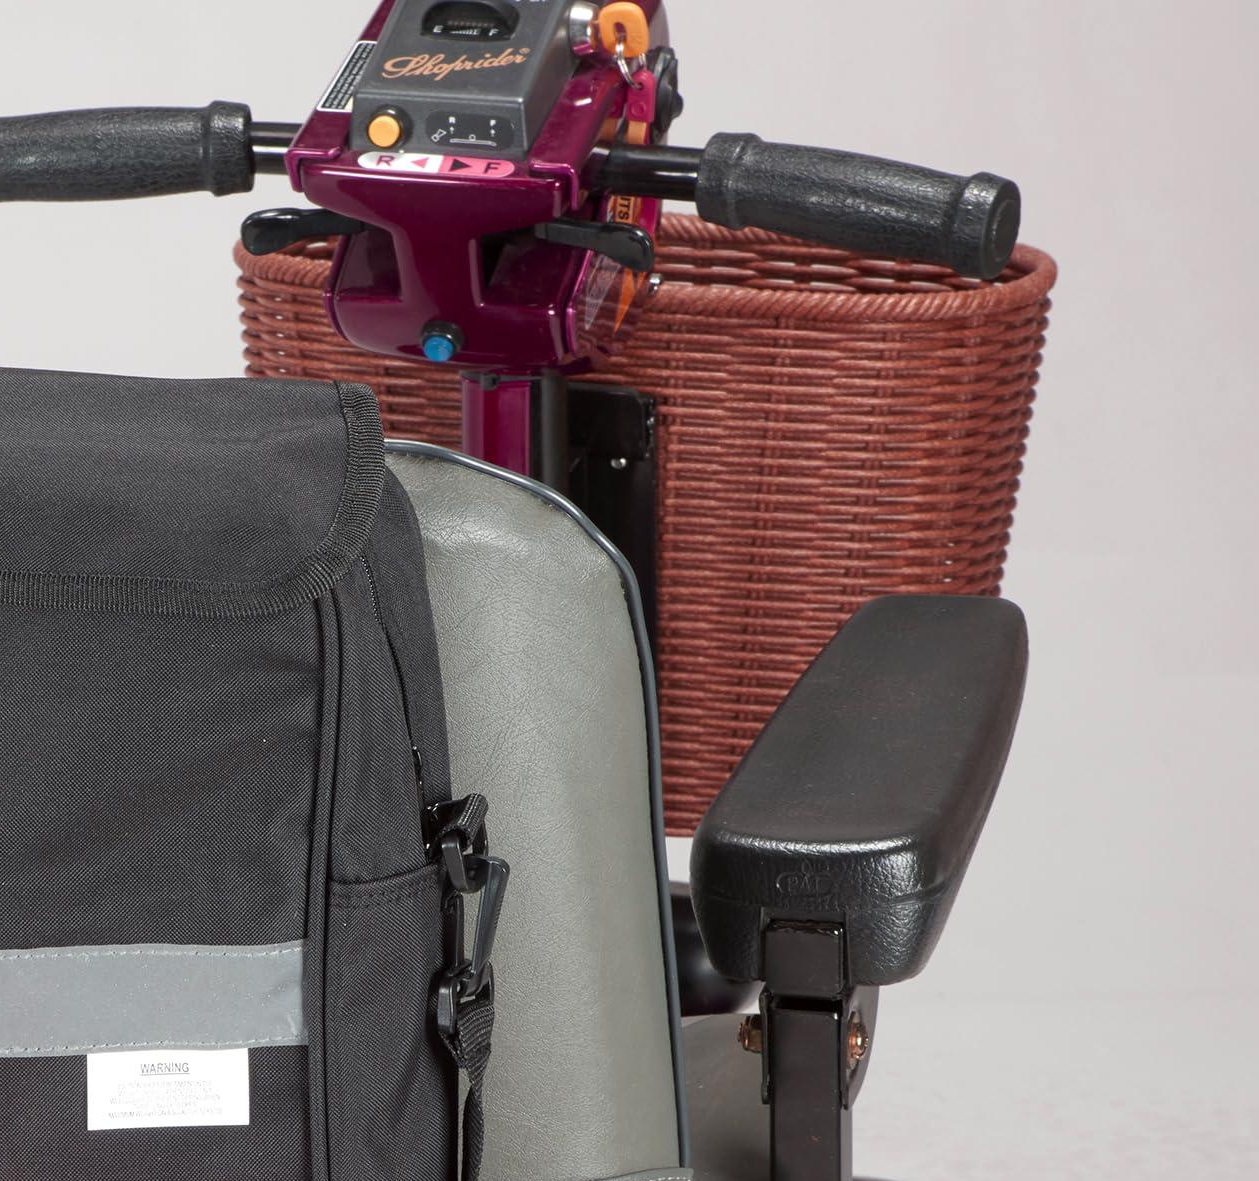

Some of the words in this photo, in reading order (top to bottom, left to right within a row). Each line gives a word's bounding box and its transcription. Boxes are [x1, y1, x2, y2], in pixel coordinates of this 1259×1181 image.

[432, 25, 442, 34] E
[488, 28, 500, 36] F
[381, 48, 529, 81] Shoprider
[376, 154, 396, 167] R
[483, 161, 502, 174] F
[140, 1062, 190, 1074] WARNING
